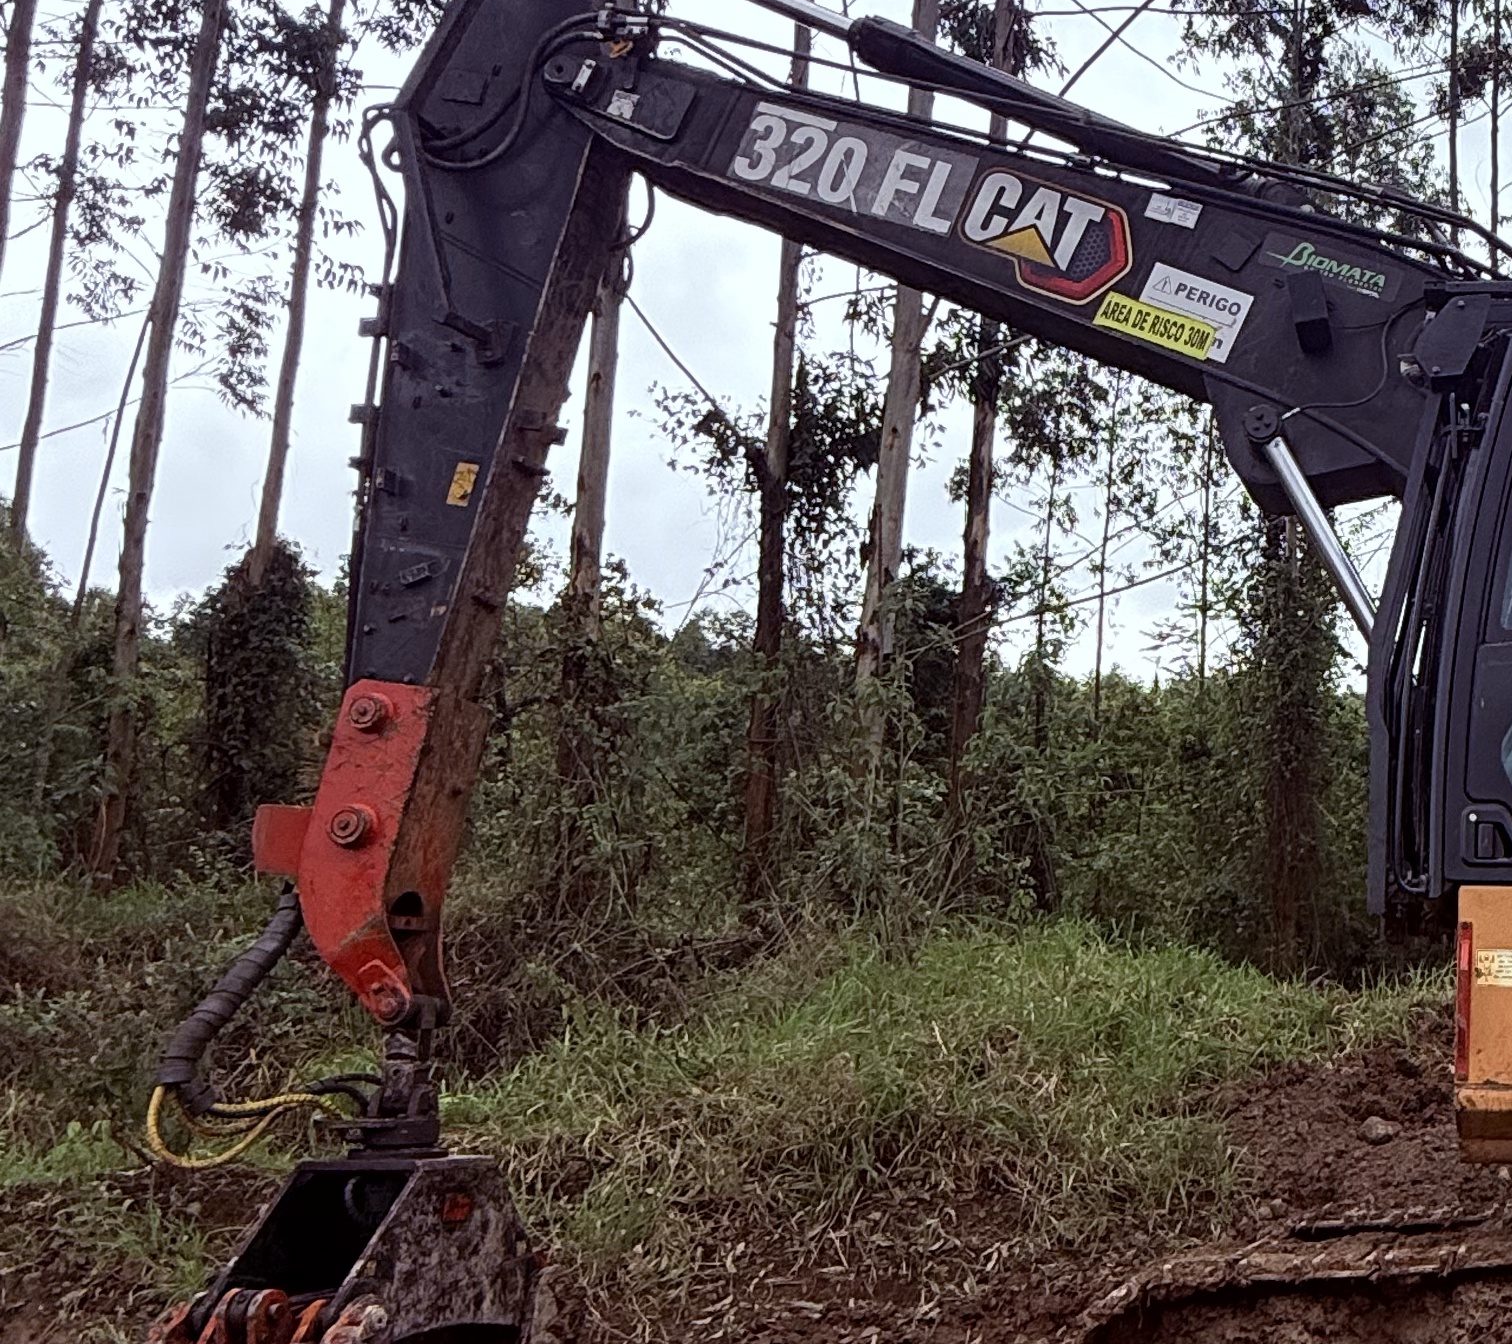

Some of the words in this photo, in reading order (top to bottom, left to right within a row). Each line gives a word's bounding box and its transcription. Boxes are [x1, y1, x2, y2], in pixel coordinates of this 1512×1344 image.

[733, 114, 869, 203] 320
[871, 148, 953, 234] FL
[964, 172, 1106, 272] CAT
[1266, 241, 1387, 288] BIOMATA
[1100, 295, 1133, 326] ÁREA
[1130, 308, 1152, 332] DE
[1149, 314, 1186, 344] RISCO
[1183, 326, 1211, 352] 30M
[1174, 281, 1242, 317] PERIGO
